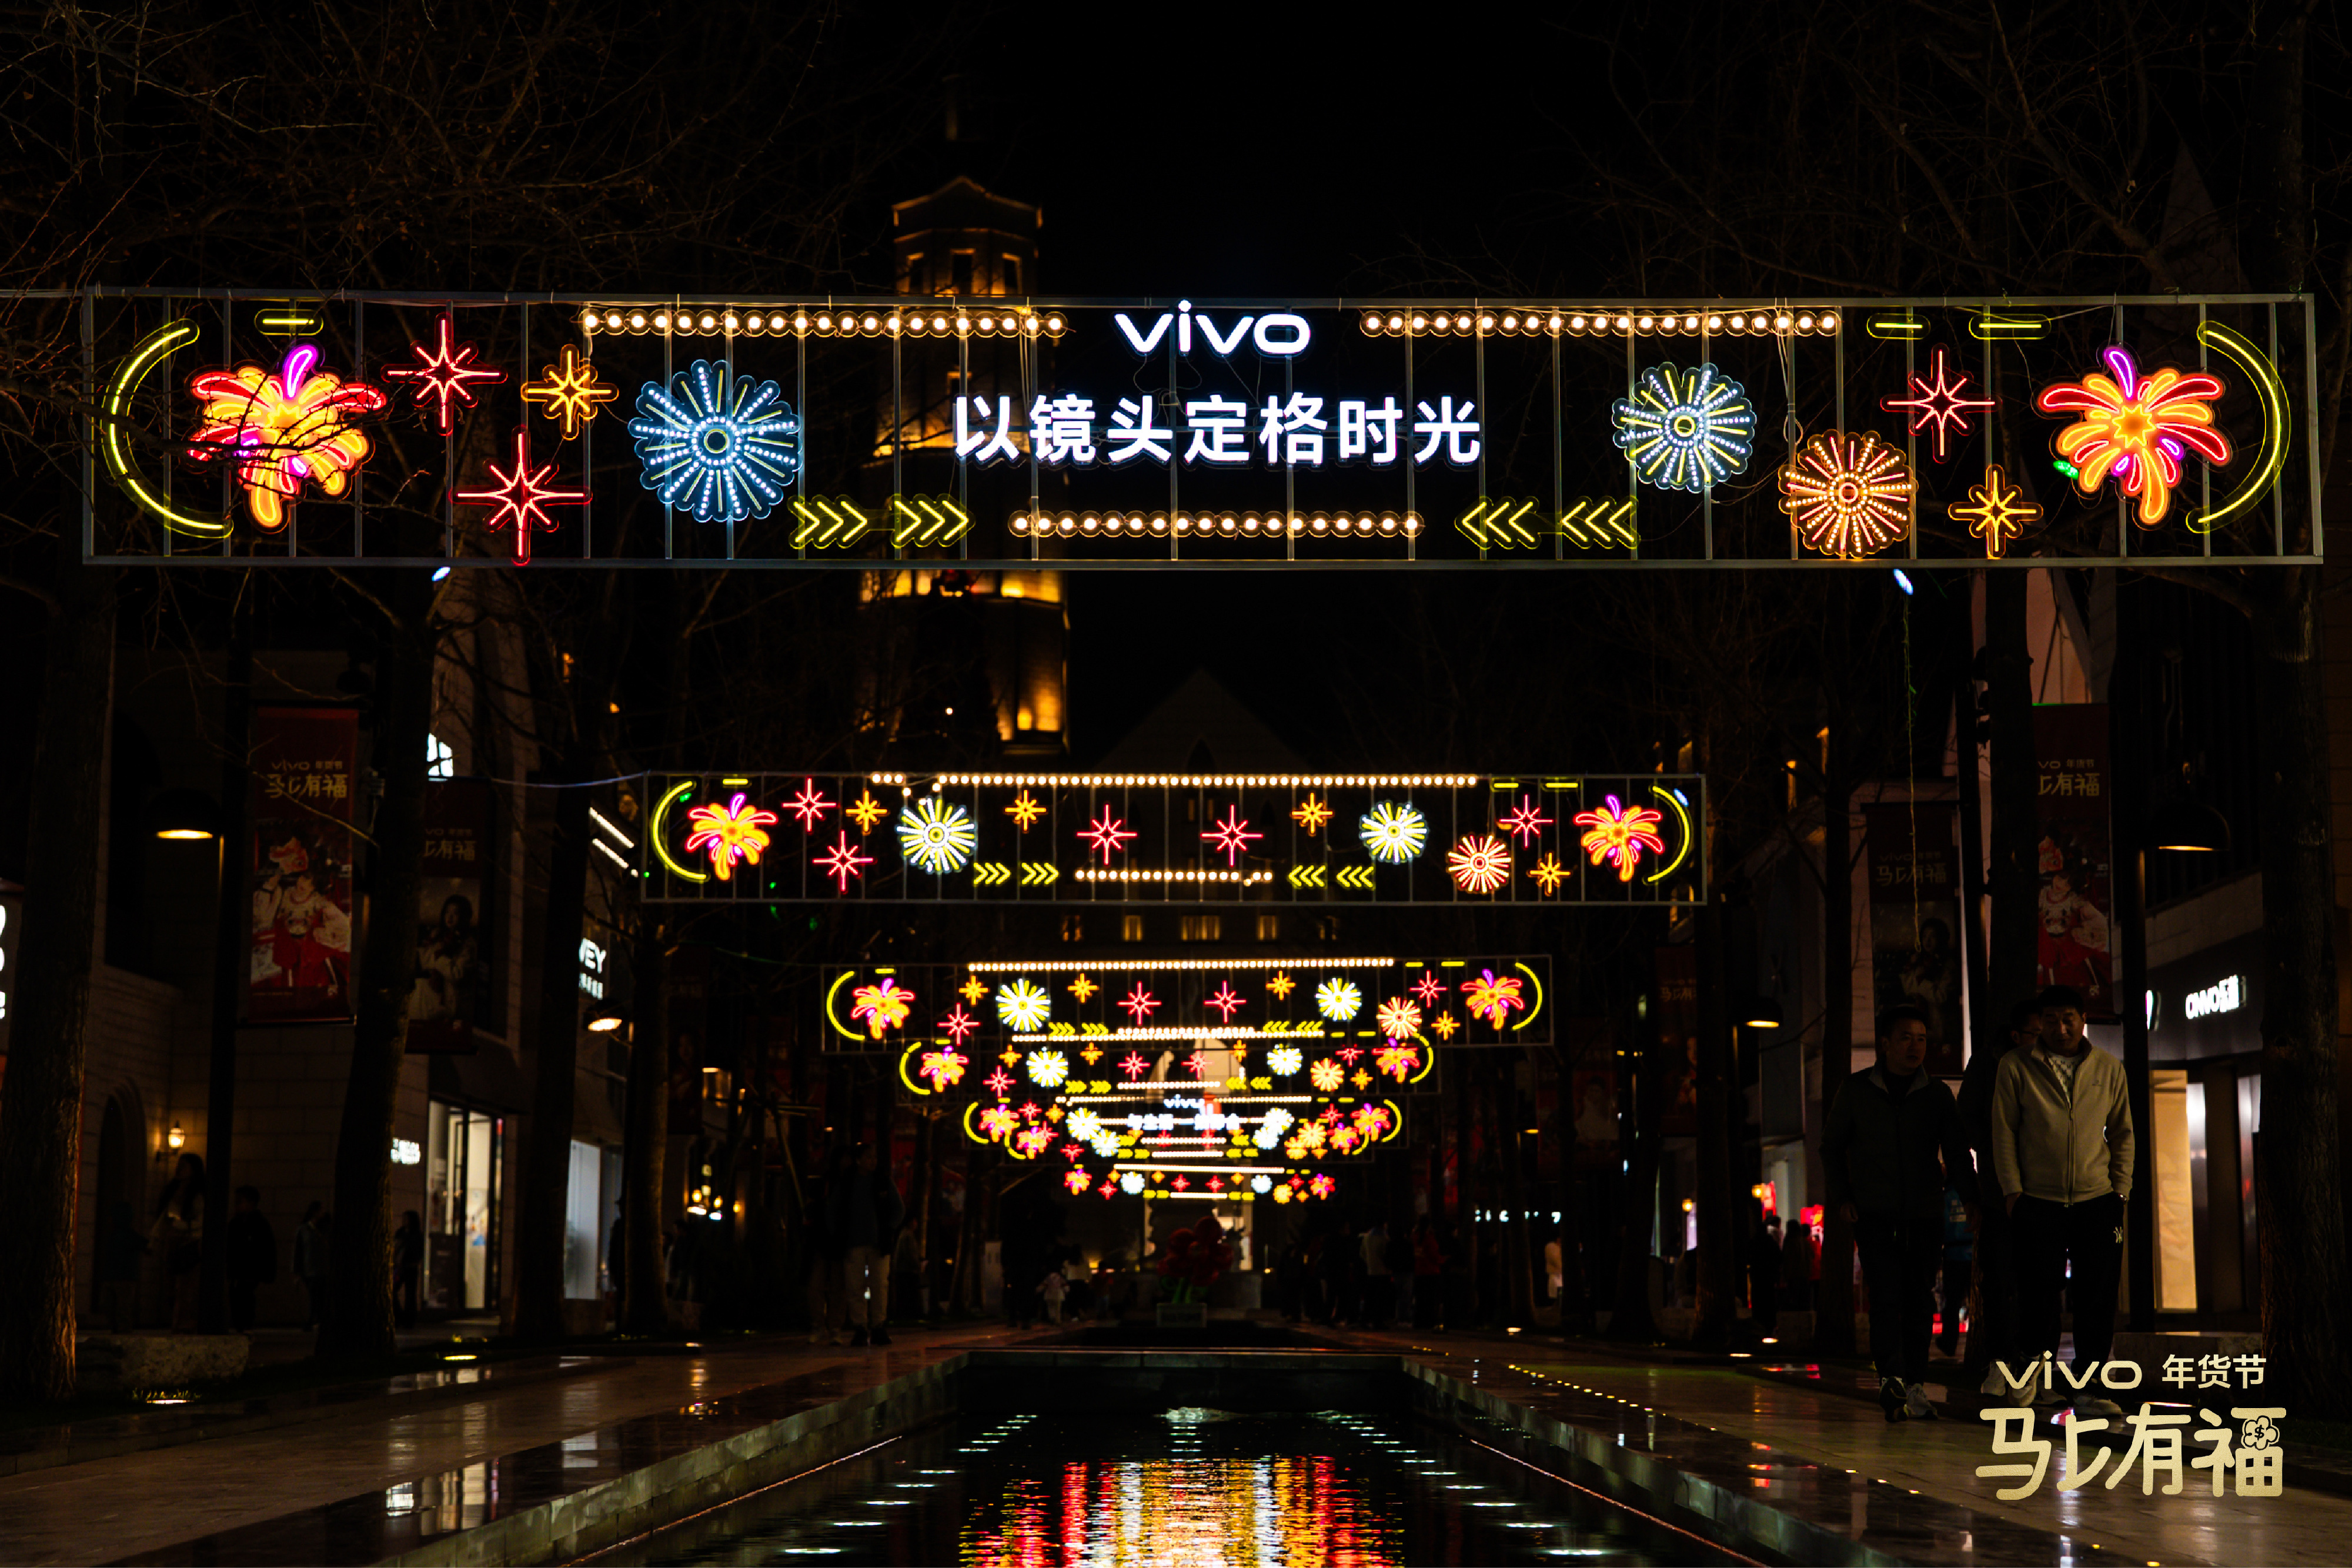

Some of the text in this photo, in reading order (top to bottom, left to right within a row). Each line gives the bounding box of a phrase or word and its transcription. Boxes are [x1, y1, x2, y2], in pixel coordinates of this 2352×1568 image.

[1115, 300, 1310, 355] vivo
[955, 392, 1481, 465] 以镜头定格时光
[271, 759, 310, 771] vivo
[2037, 771, 2100, 797] 上有福
